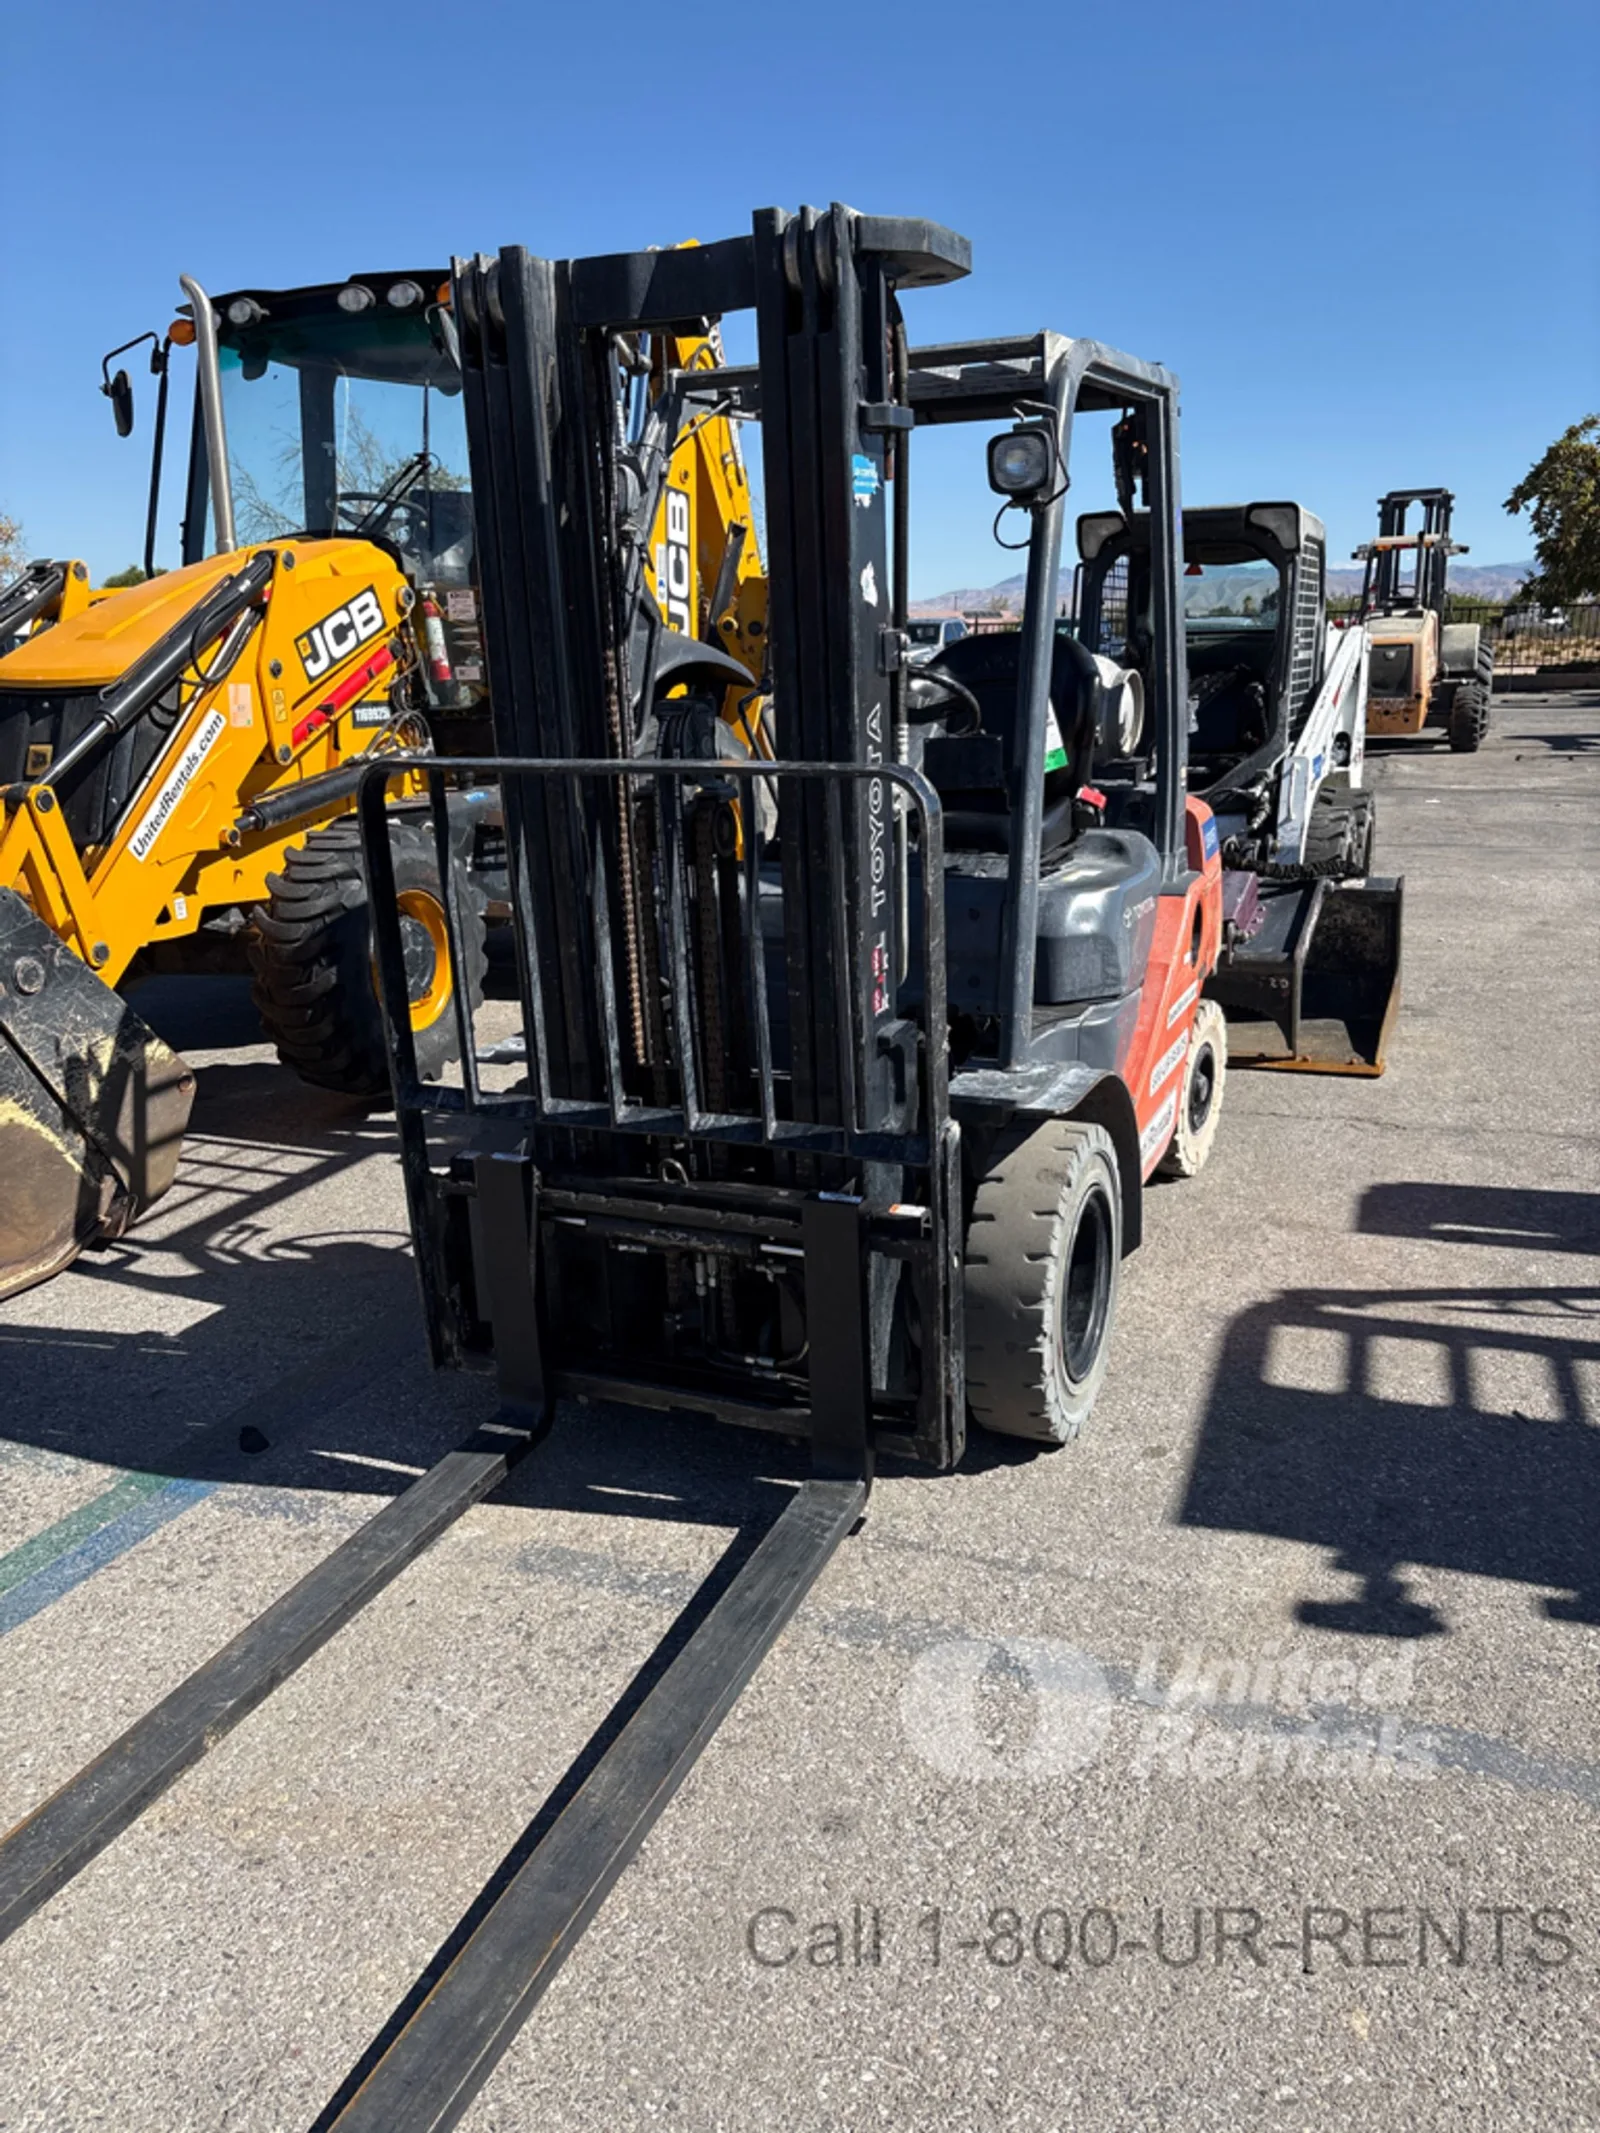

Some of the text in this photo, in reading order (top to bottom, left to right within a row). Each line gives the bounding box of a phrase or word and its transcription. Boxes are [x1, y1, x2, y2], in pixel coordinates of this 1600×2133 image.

[304, 591, 384, 677] JCB
[132, 714, 223, 857] UnitedRentals.com
[867, 702, 886, 918] TOYOTA
